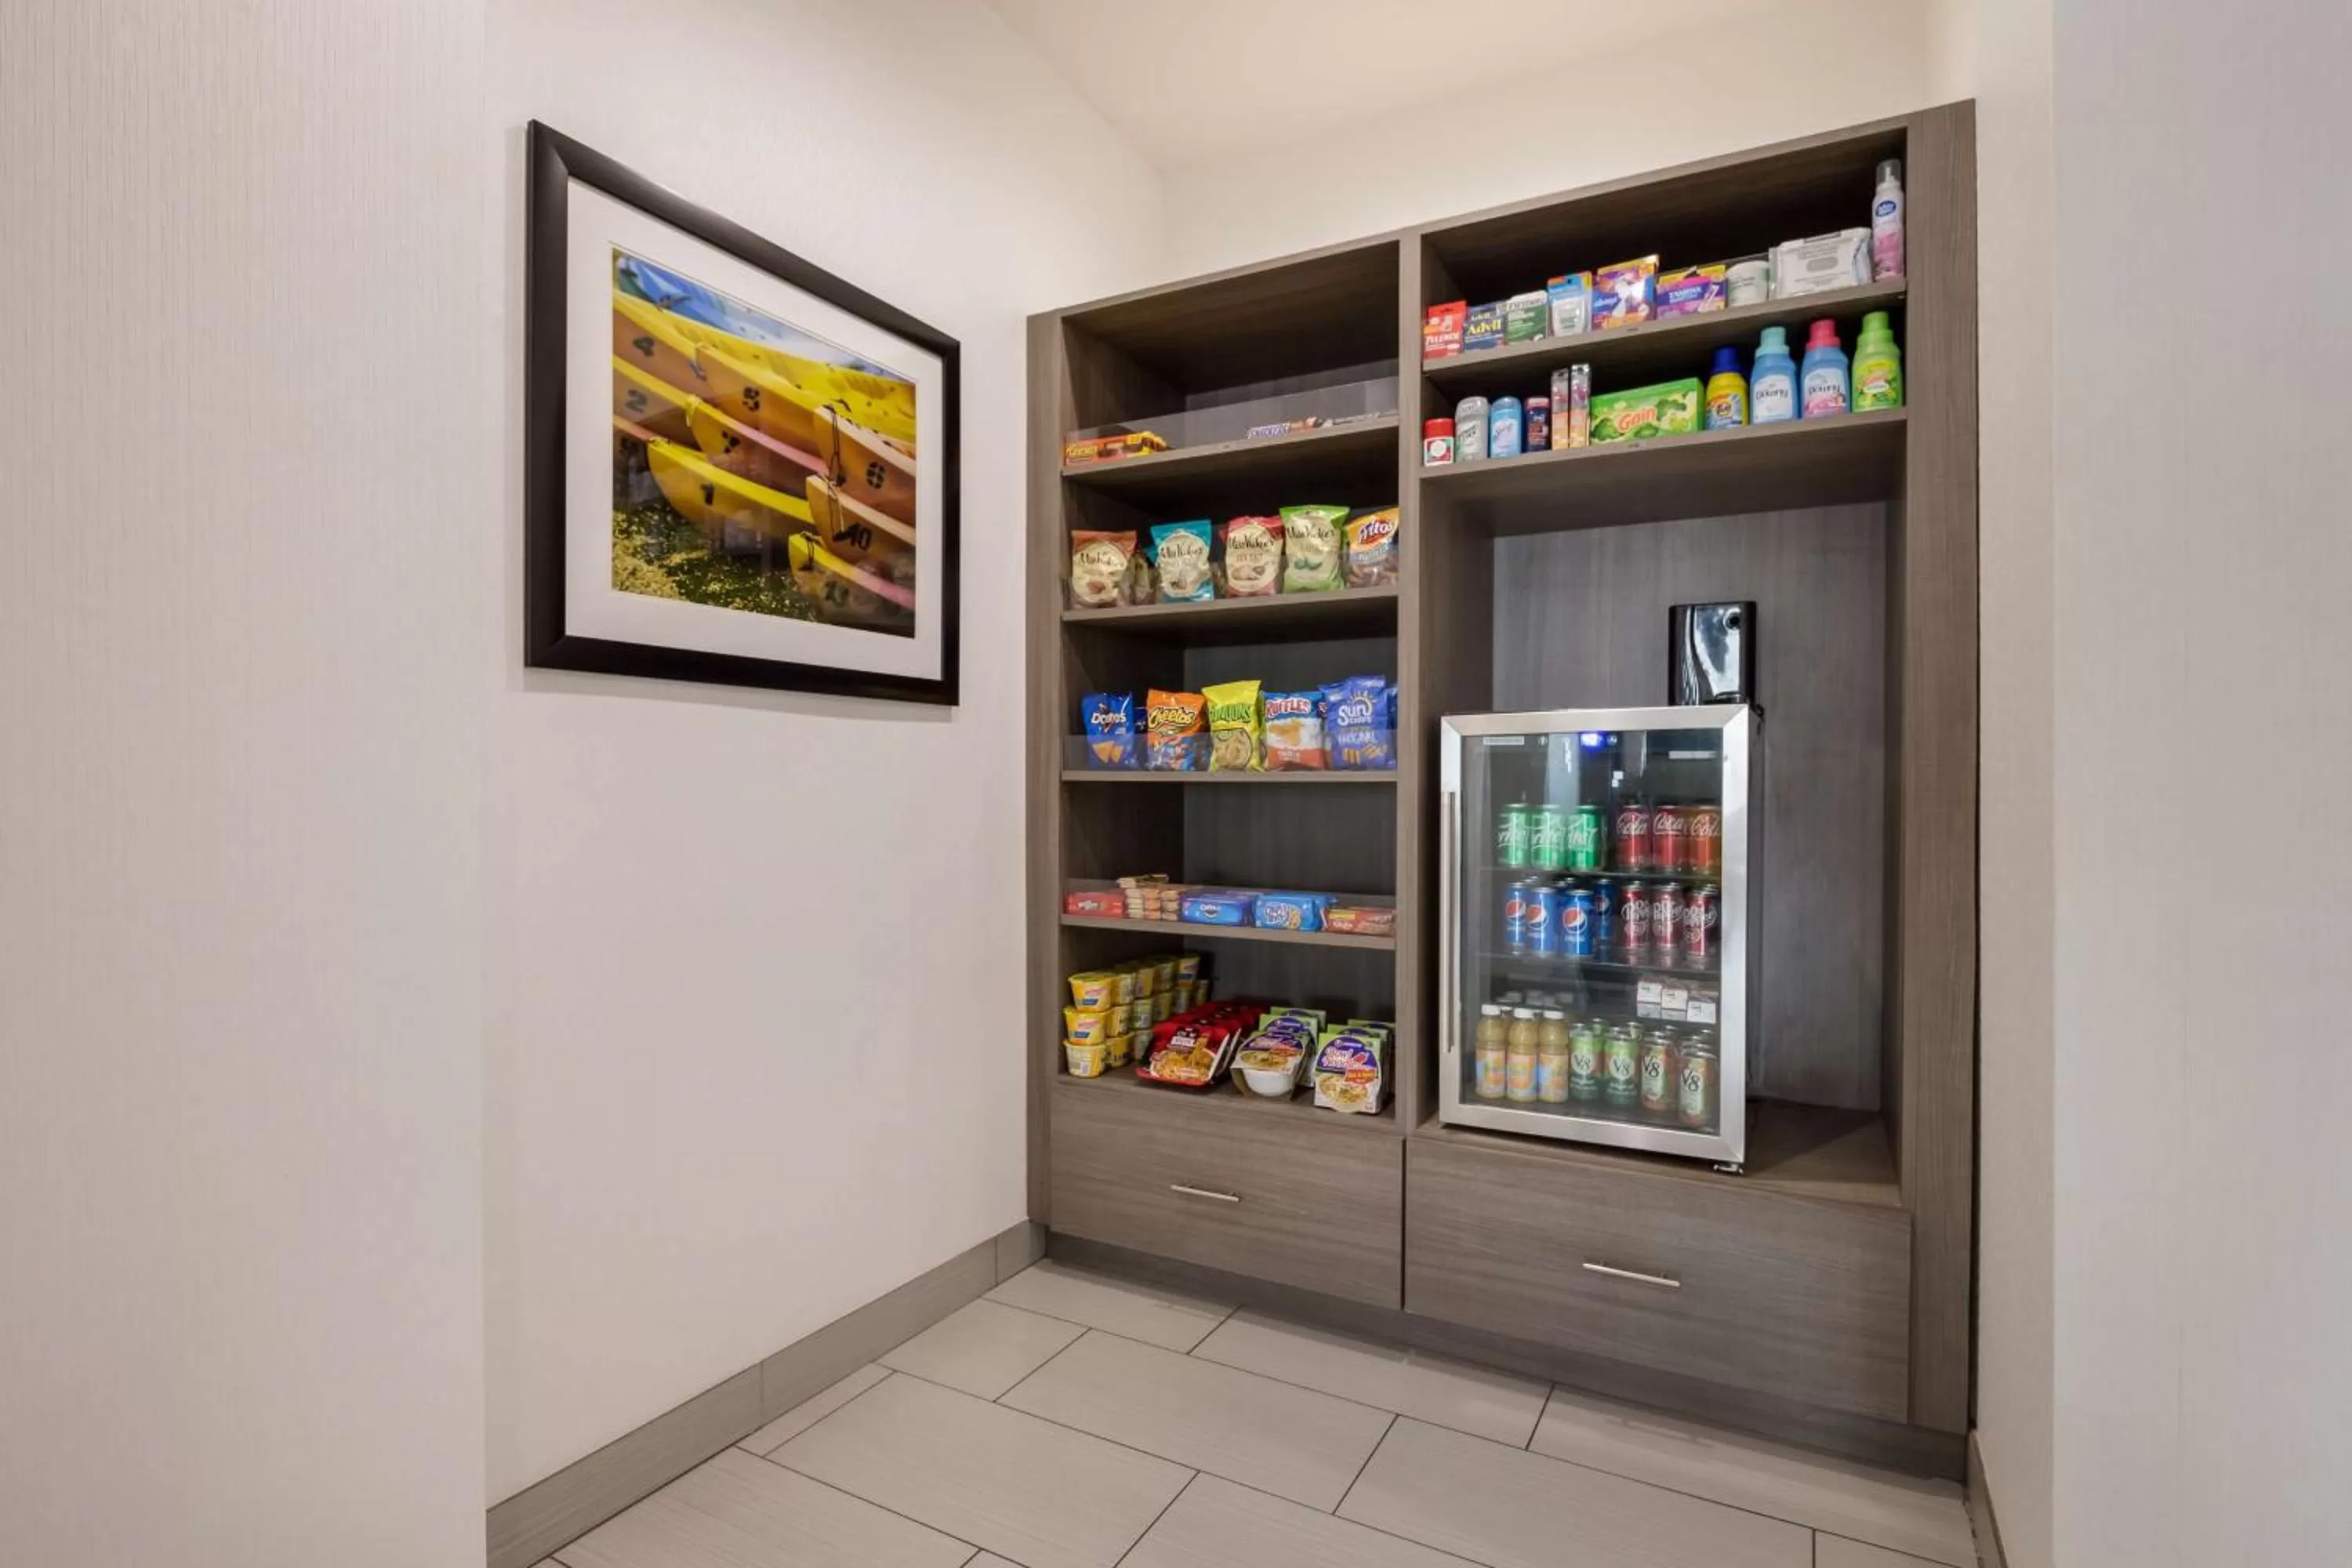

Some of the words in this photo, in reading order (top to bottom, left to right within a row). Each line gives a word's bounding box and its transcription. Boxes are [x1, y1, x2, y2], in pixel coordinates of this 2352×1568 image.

[1468, 319, 1501, 336] Advil
[1617, 408, 1657, 431] Gain
[1091, 711, 1127, 724] Doritos
[1148, 706, 1195, 728] Cheetos
[1338, 704, 1370, 727] Sun
[1613, 1058, 1631, 1076] V8
[1643, 1056, 1661, 1078] V8
[1682, 1067, 1700, 1091] V8
